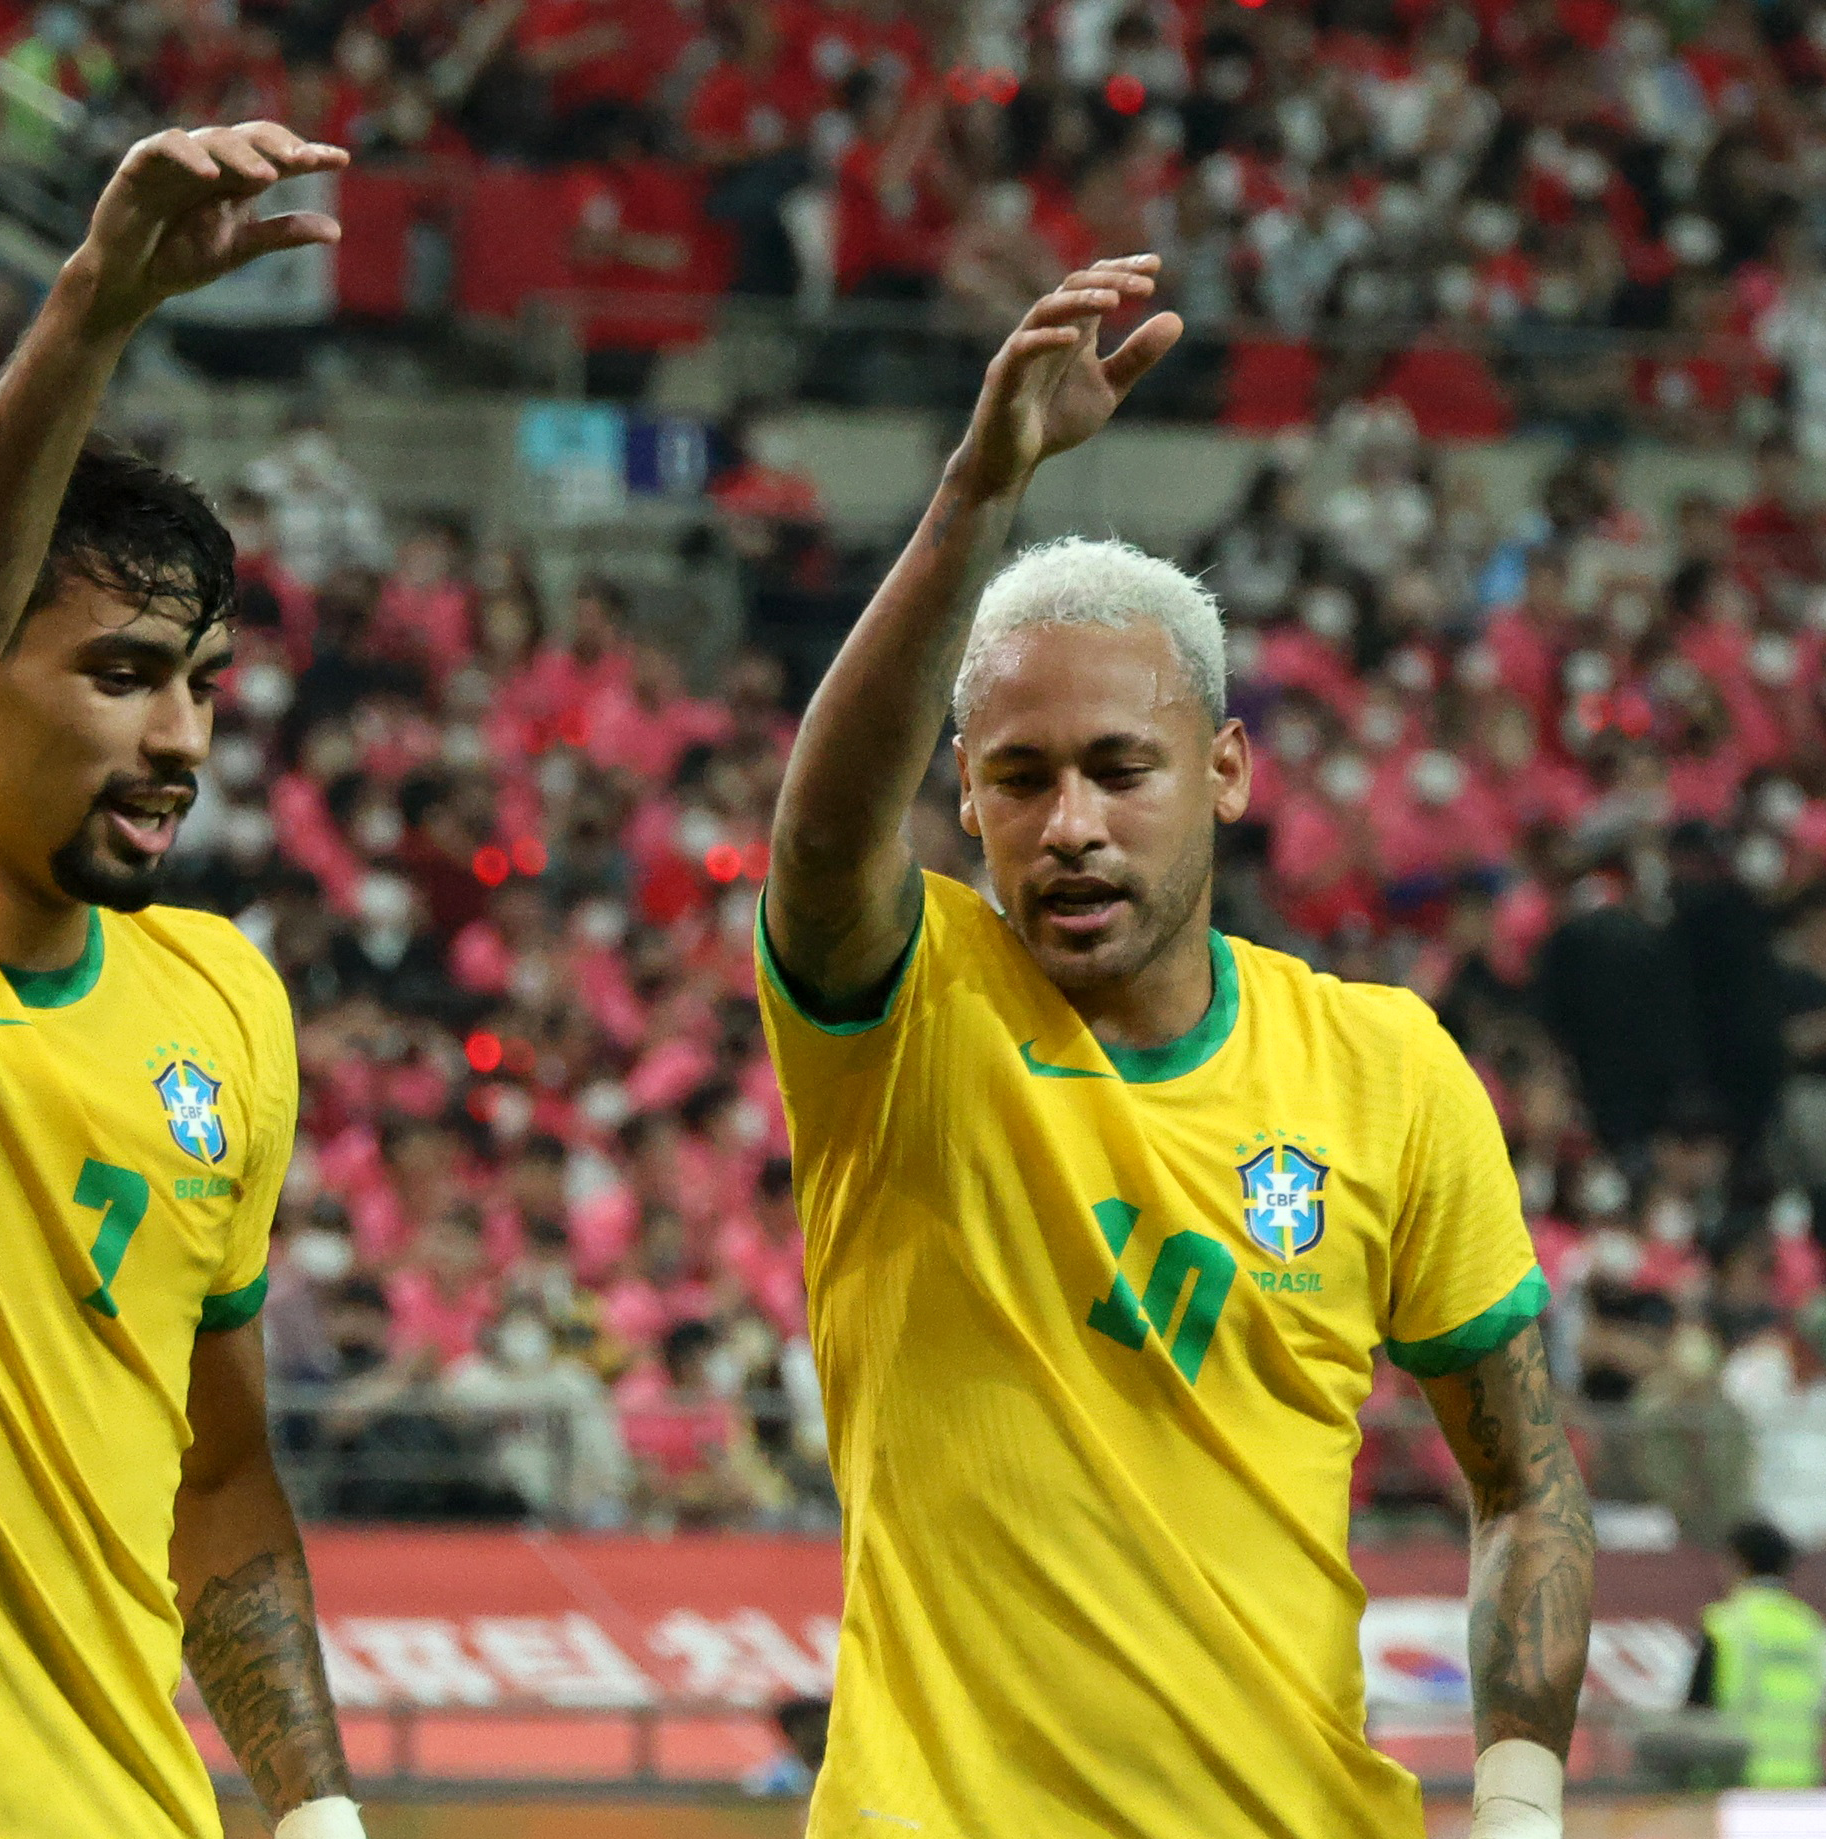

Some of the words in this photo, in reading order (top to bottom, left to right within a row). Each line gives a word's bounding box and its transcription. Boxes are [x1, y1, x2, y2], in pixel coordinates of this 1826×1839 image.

[180, 1105, 203, 1119] CBF
[72, 1157, 150, 1318] 7
[1266, 1193, 1298, 1207] CBF
[1085, 1197, 1237, 1386] 10
